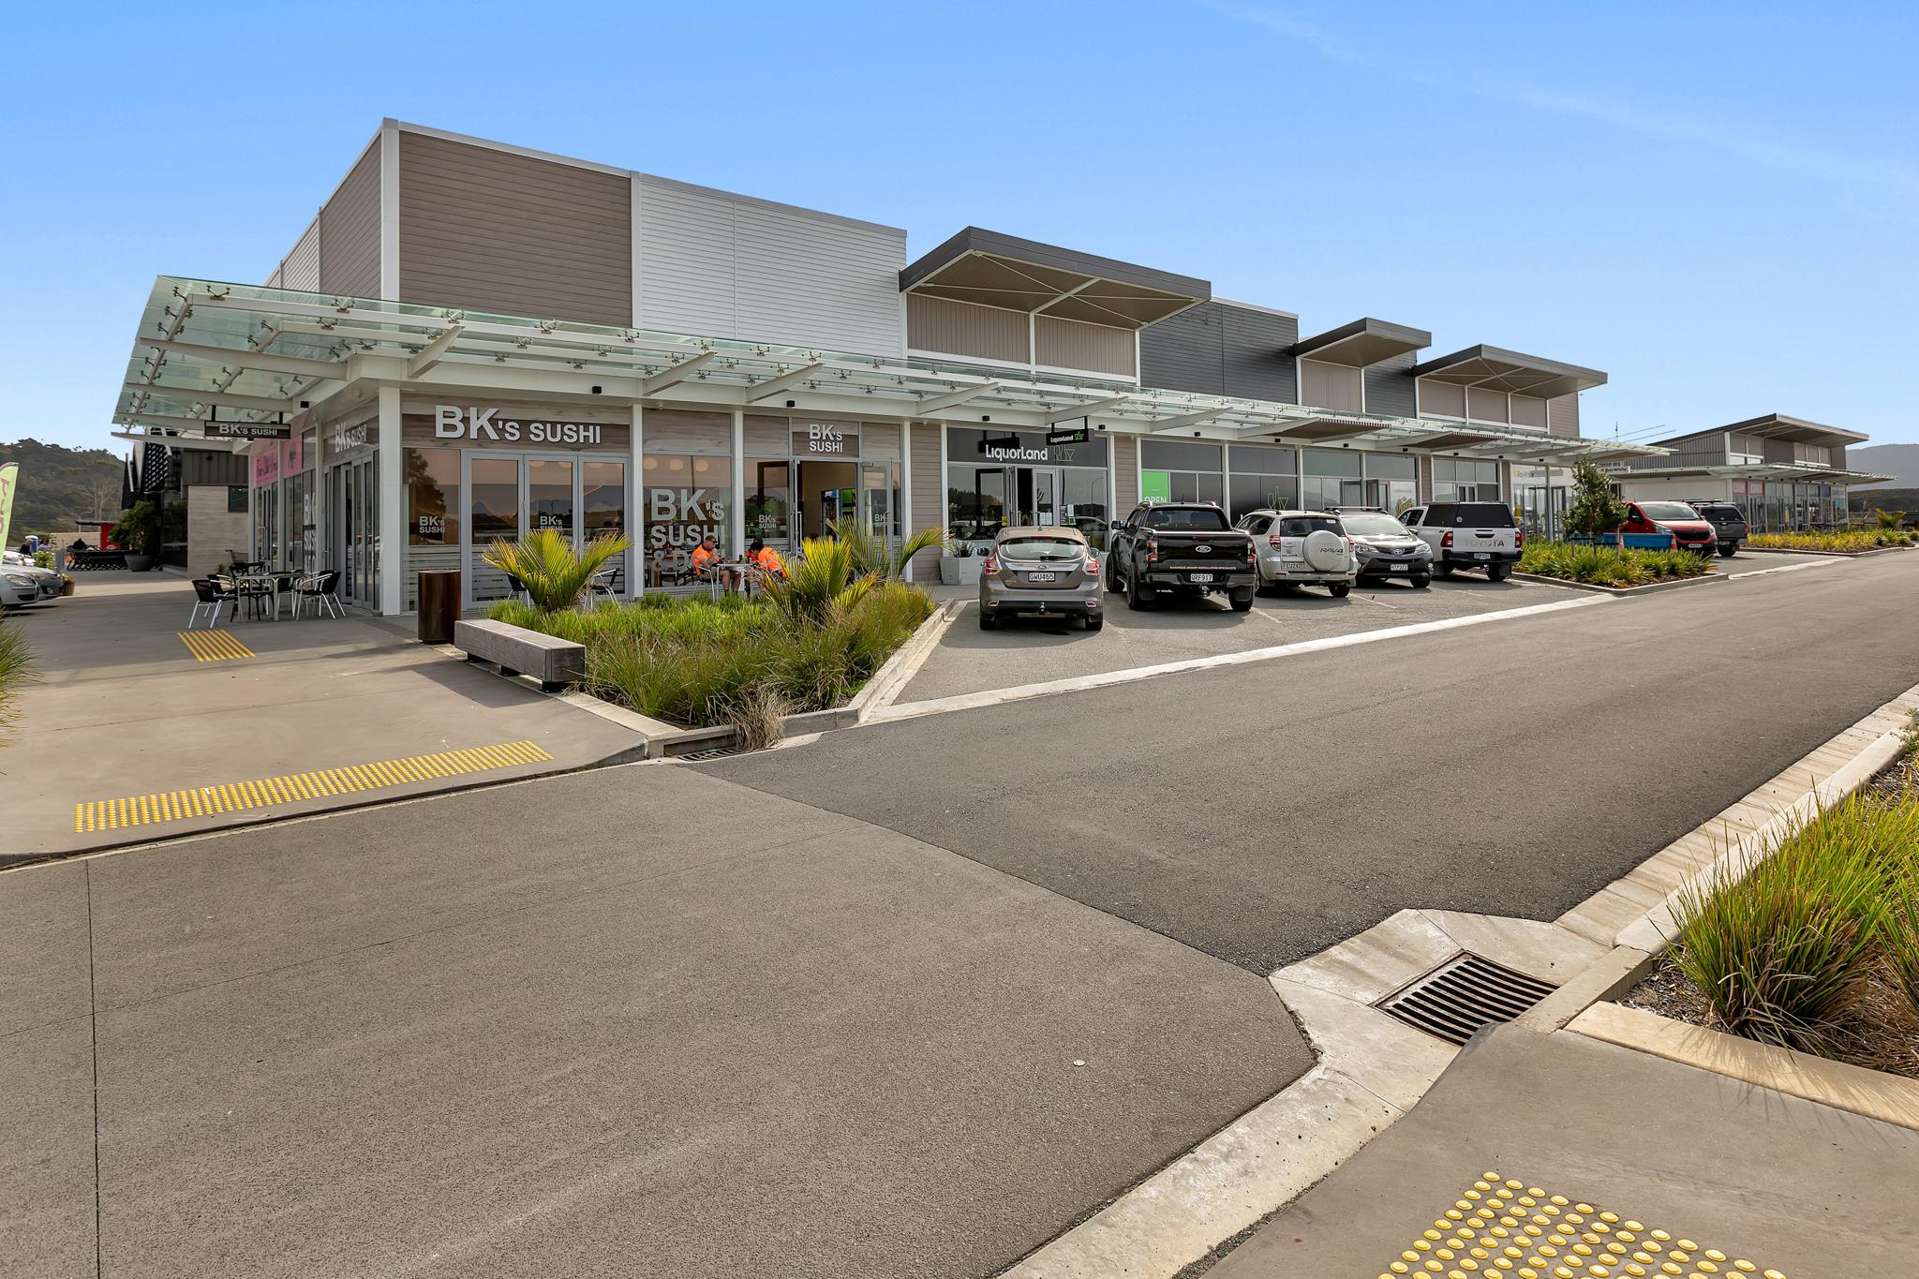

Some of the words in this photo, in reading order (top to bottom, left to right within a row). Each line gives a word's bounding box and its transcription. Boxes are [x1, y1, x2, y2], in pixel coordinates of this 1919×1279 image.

[219, 423, 248, 435] BK's
[251, 428, 278, 437] SUSHI
[435, 405, 520, 441] BK's
[529, 423, 601, 444] SUSHI
[809, 424, 843, 441] BK's
[809, 441, 843, 453] SUSHI
[651, 489, 725, 521] BK's
[1144, 495, 1167, 503] OPEN
[419, 515, 445, 527] BK's
[540, 515, 563, 526] BK's
[419, 526, 446, 534] SUSHI
[650, 525, 725, 547] SUSHI
